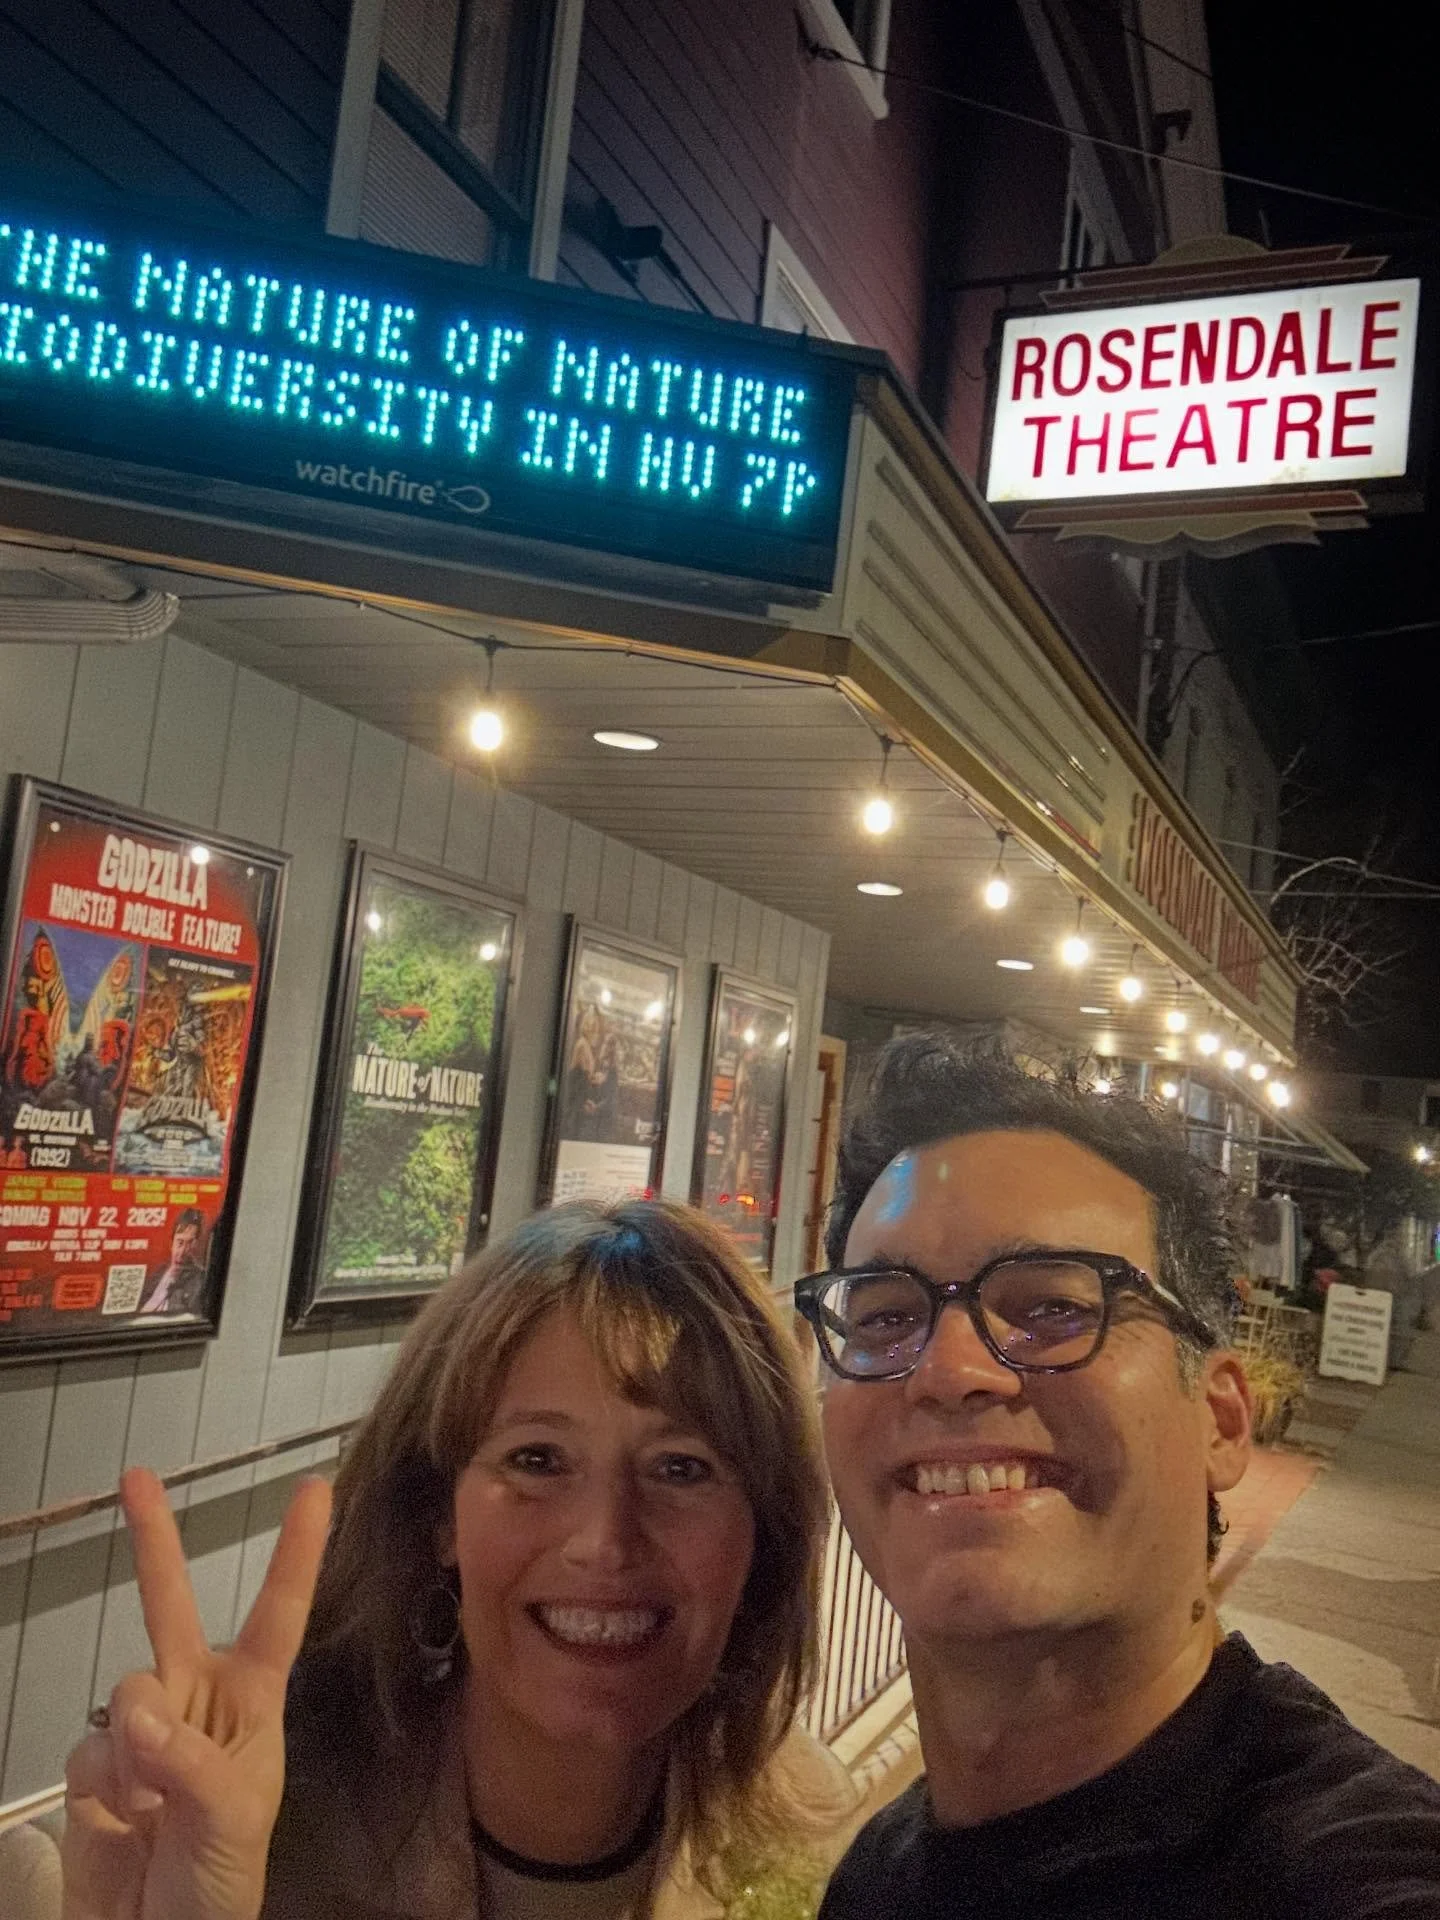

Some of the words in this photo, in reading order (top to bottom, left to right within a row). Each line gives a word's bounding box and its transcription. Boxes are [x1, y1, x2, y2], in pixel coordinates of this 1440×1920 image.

[0, 223, 105, 299] HE
[134, 250, 415, 364] NATURE
[444, 318, 525, 382] OF
[550, 338, 806, 445] NATURE
[1010, 301, 1401, 401] ROSENDALE
[520, 407, 612, 481] IN
[1023, 388, 1378, 478] THEATRE
[295, 459, 437, 505] watchfire
[97, 833, 208, 911] GODZILLA
[48, 882, 117, 930] MONSTER
[121, 901, 176, 942] DOUBLE
[180, 914, 242, 955] FEATURE!
[352, 1054, 419, 1100] NATURE
[429, 1065, 484, 1108] NATURE
[13, 1103, 95, 1136] GODZILLA
[0, 1205, 51, 1227] OMING
[58, 1205, 92, 1227] NOV
[126, 1206, 168, 1228] 2025!
